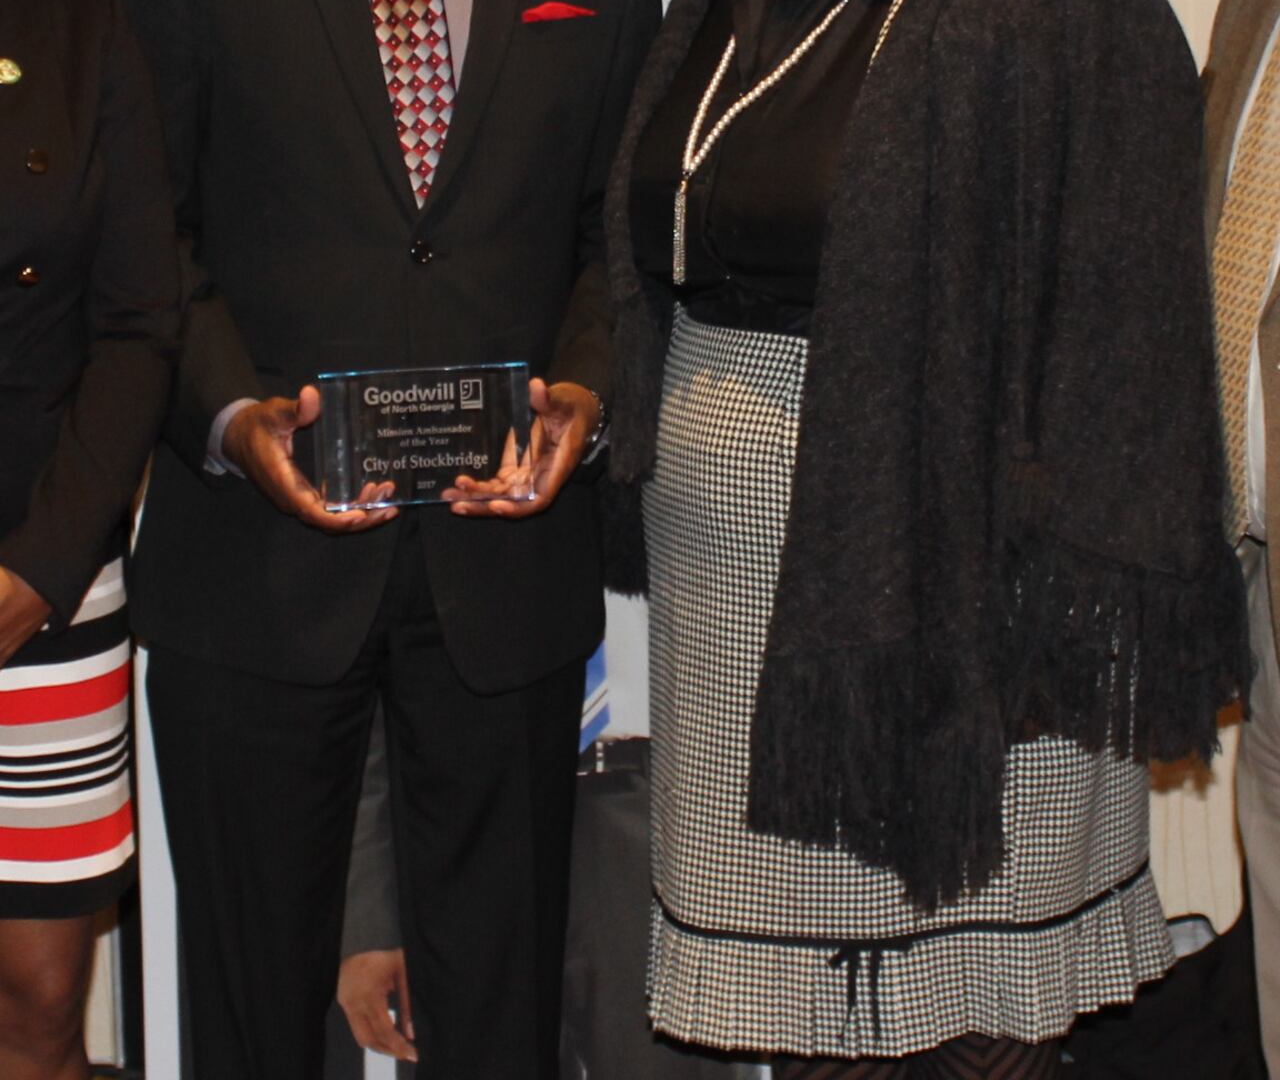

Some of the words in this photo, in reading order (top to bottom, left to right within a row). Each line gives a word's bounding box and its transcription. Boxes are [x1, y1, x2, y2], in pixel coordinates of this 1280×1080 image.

[363, 383, 455, 406] Goodwill
[380, 405, 391, 414] of
[391, 403, 418, 413] North
[419, 402, 455, 414] Georgia
[377, 427, 414, 438] Mission
[416, 424, 472, 435] Ambassador
[412, 438, 426, 447] the
[428, 436, 449, 446] Year
[362, 457, 390, 476] City
[393, 455, 407, 470] of
[409, 451, 489, 470] Stockbridge
